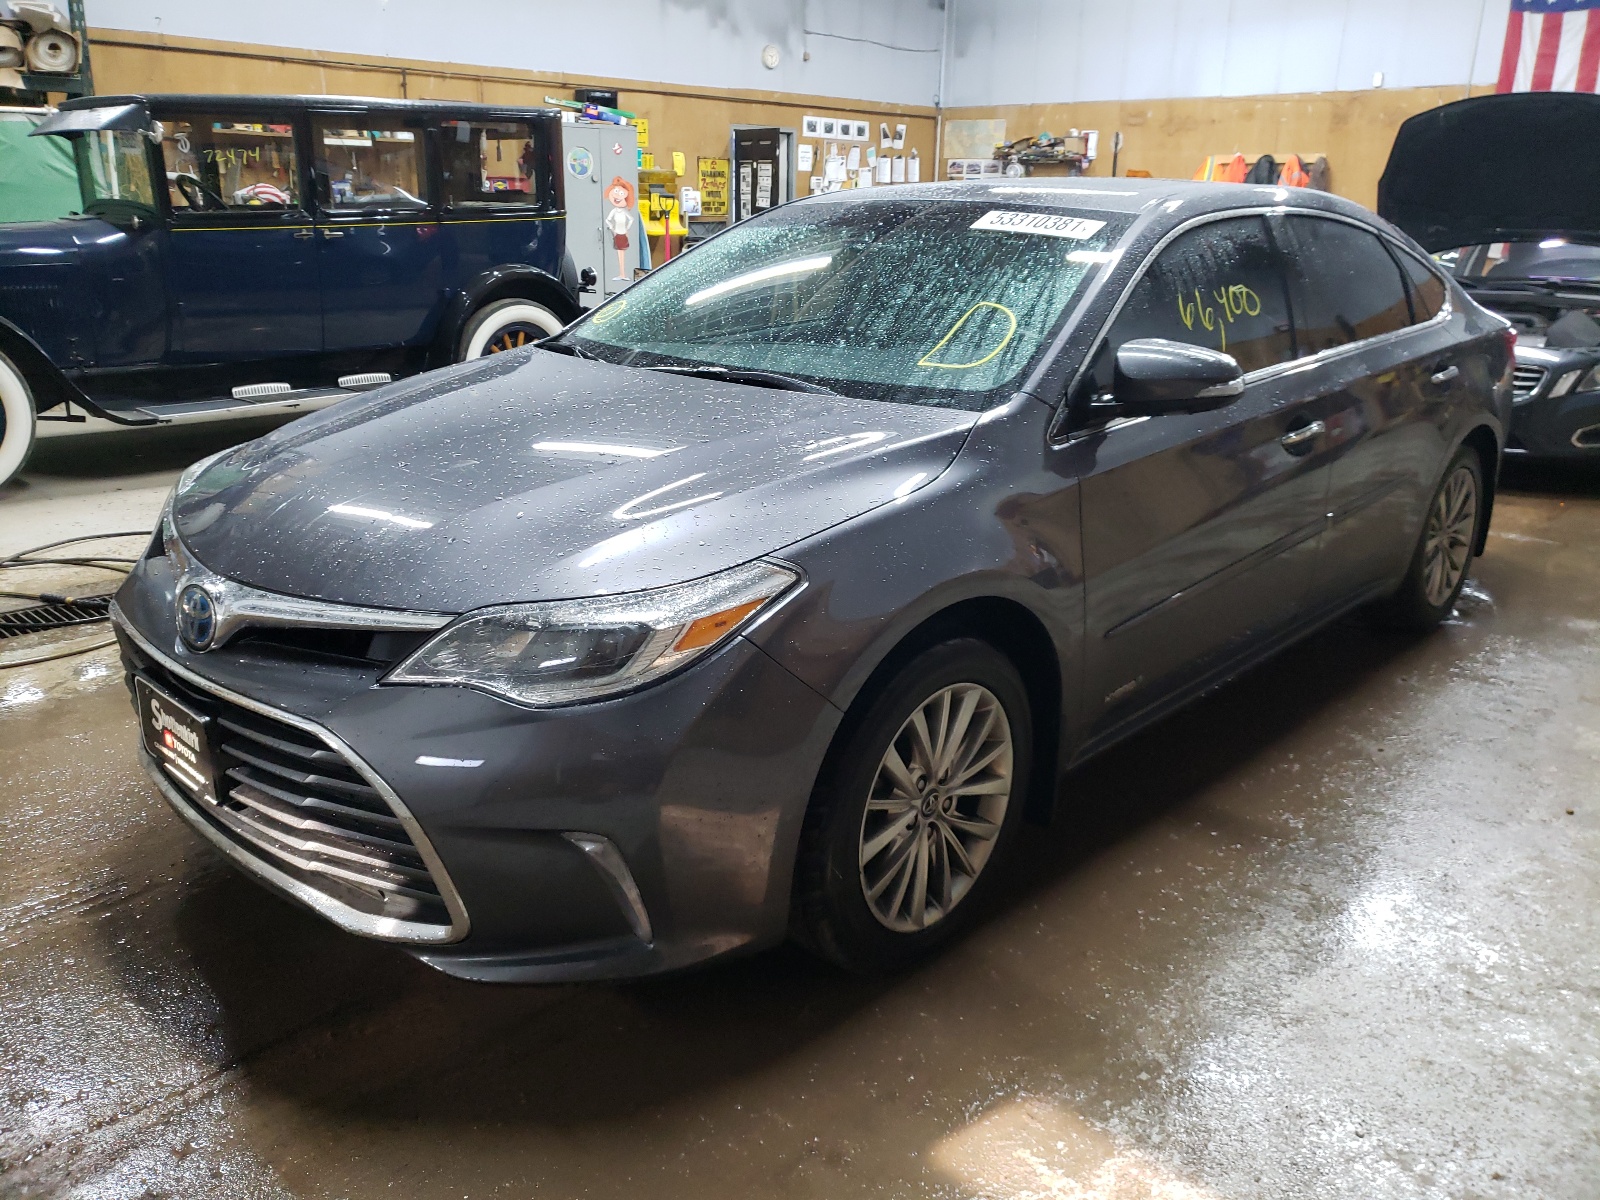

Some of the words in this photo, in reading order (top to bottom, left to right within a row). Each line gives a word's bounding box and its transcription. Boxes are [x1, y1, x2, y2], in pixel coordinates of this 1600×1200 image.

[203, 146, 260, 168] 72,474
[989, 212, 1085, 232] 53310381
[1178, 284, 1261, 352] 66,400
[917, 301, 1017, 369] D
[172, 736, 197, 764] TOYOTA
